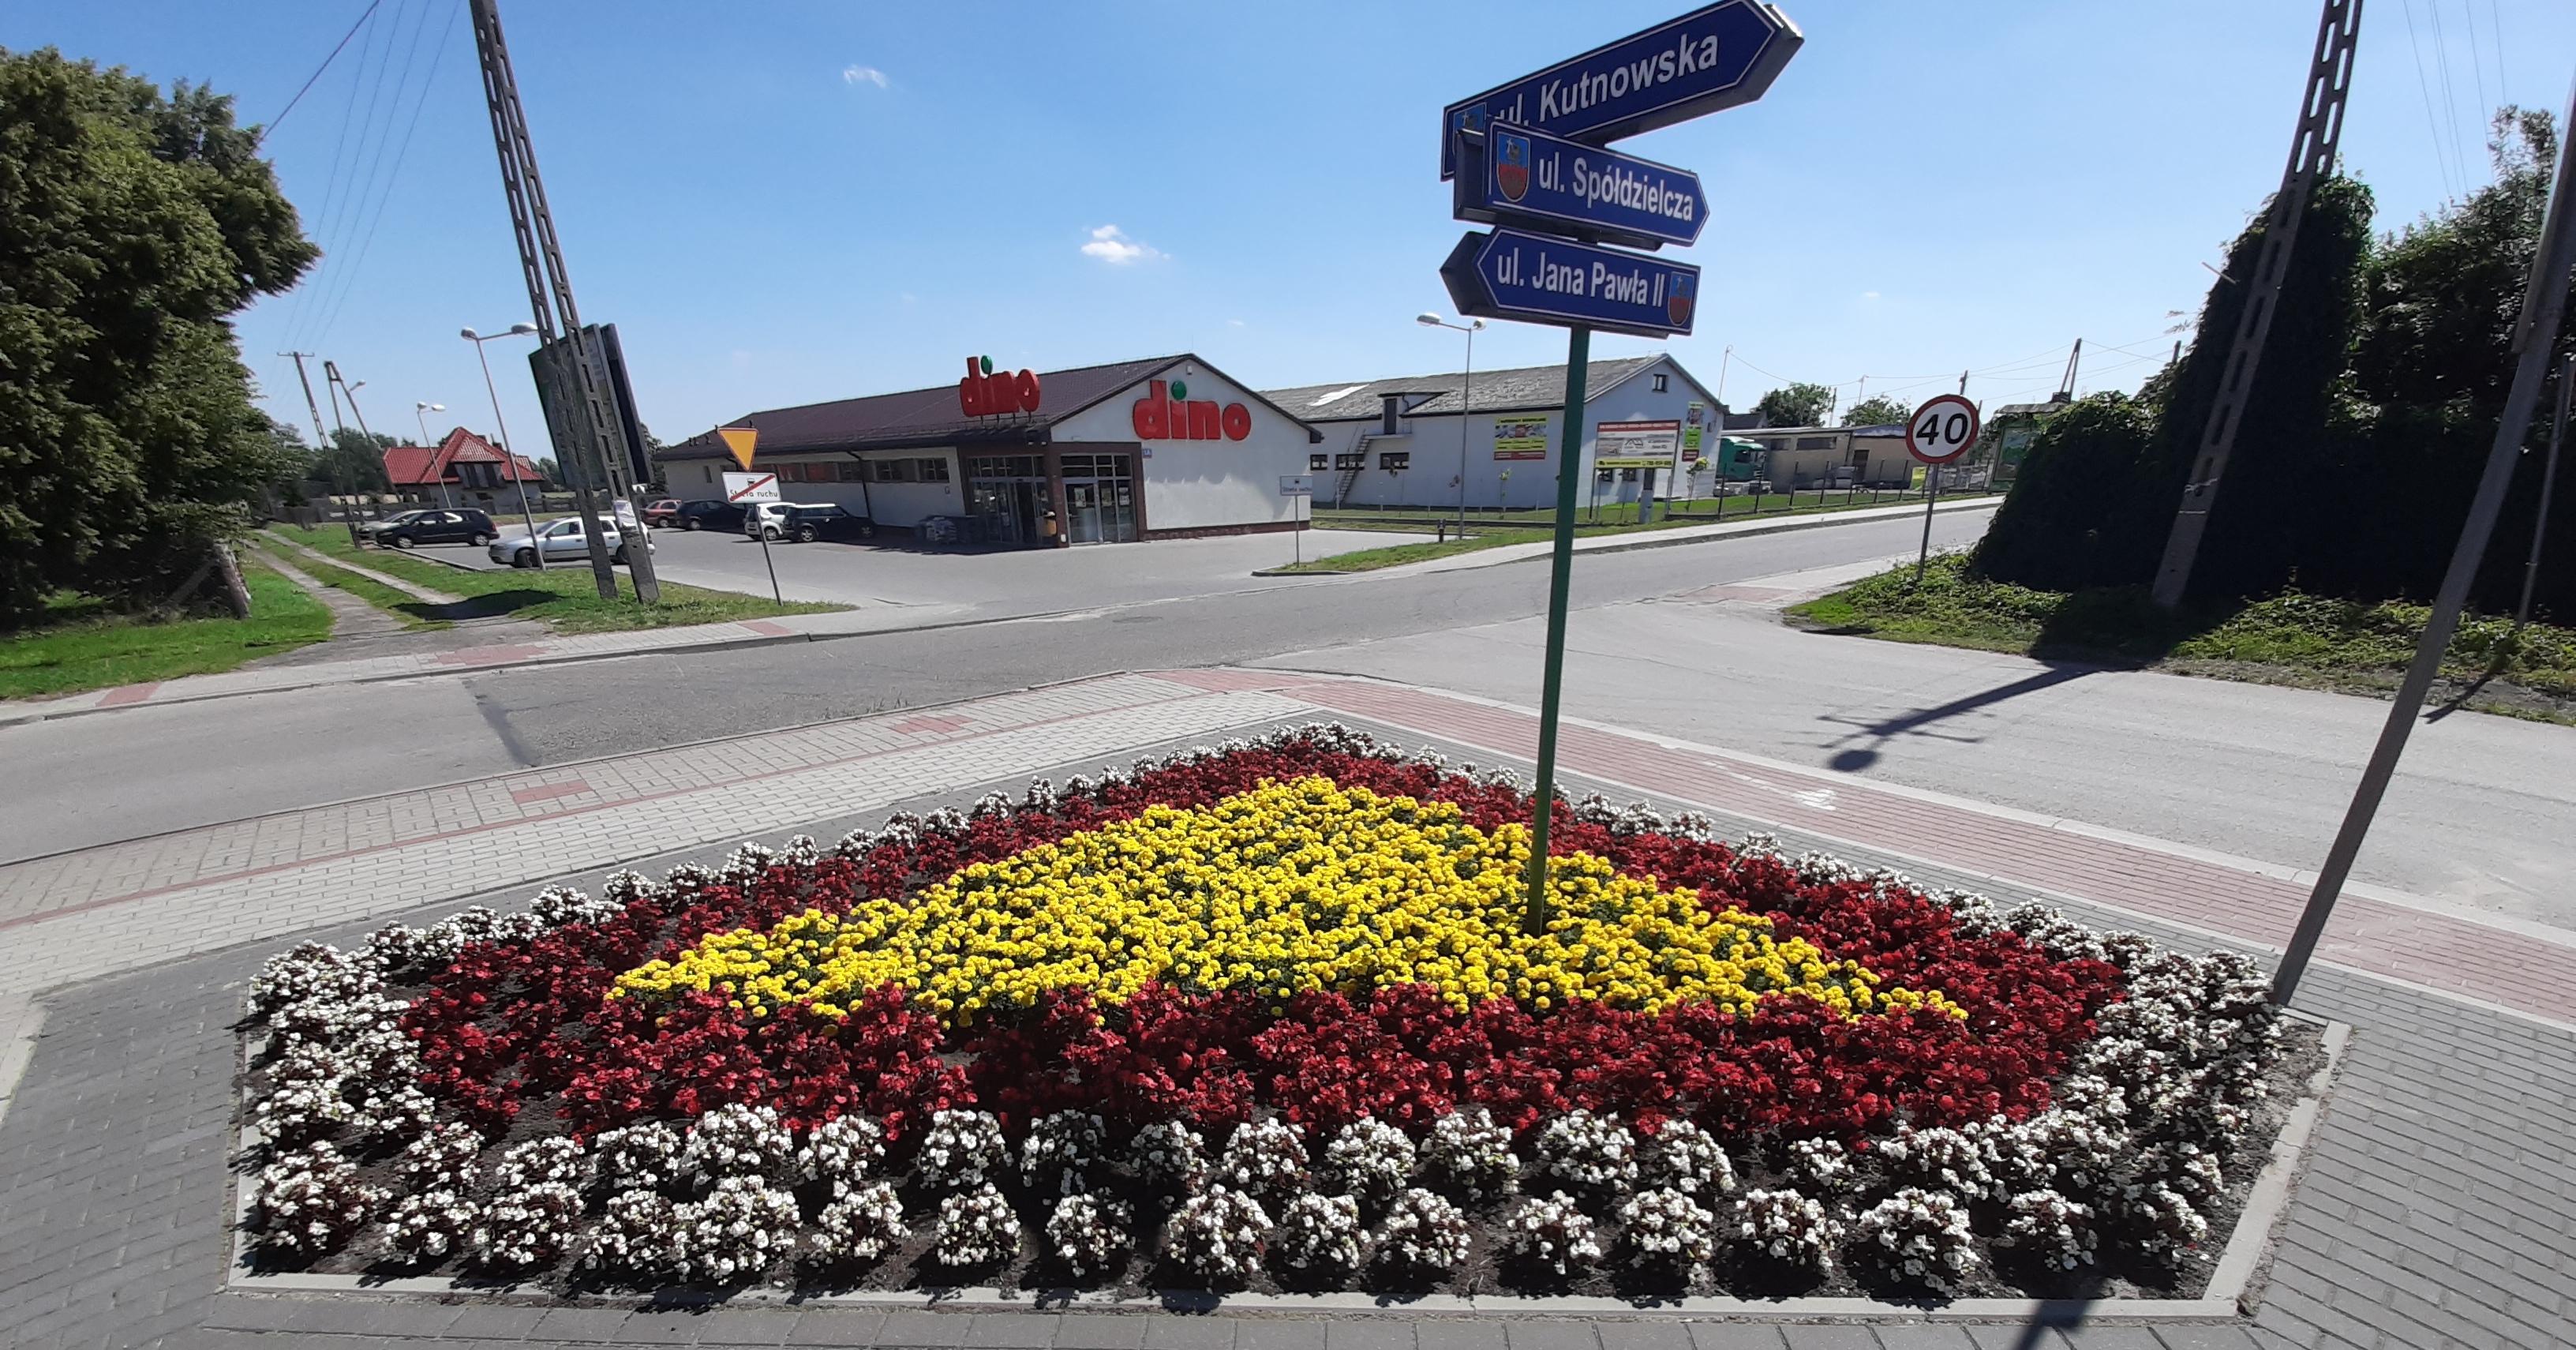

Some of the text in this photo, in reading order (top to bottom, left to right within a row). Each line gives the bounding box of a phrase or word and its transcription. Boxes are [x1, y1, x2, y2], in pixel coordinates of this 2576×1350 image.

[1539, 34, 1718, 122] Kutnowska
[1539, 152, 1693, 221] ul. Spółdzielcza
[1497, 247, 1524, 287] ul.
[1533, 252, 1584, 296] Jana
[1590, 261, 1648, 306] Pawła
[960, 354, 1040, 417] dino
[1133, 380, 1251, 441] dino
[1916, 413, 1968, 445] 40
